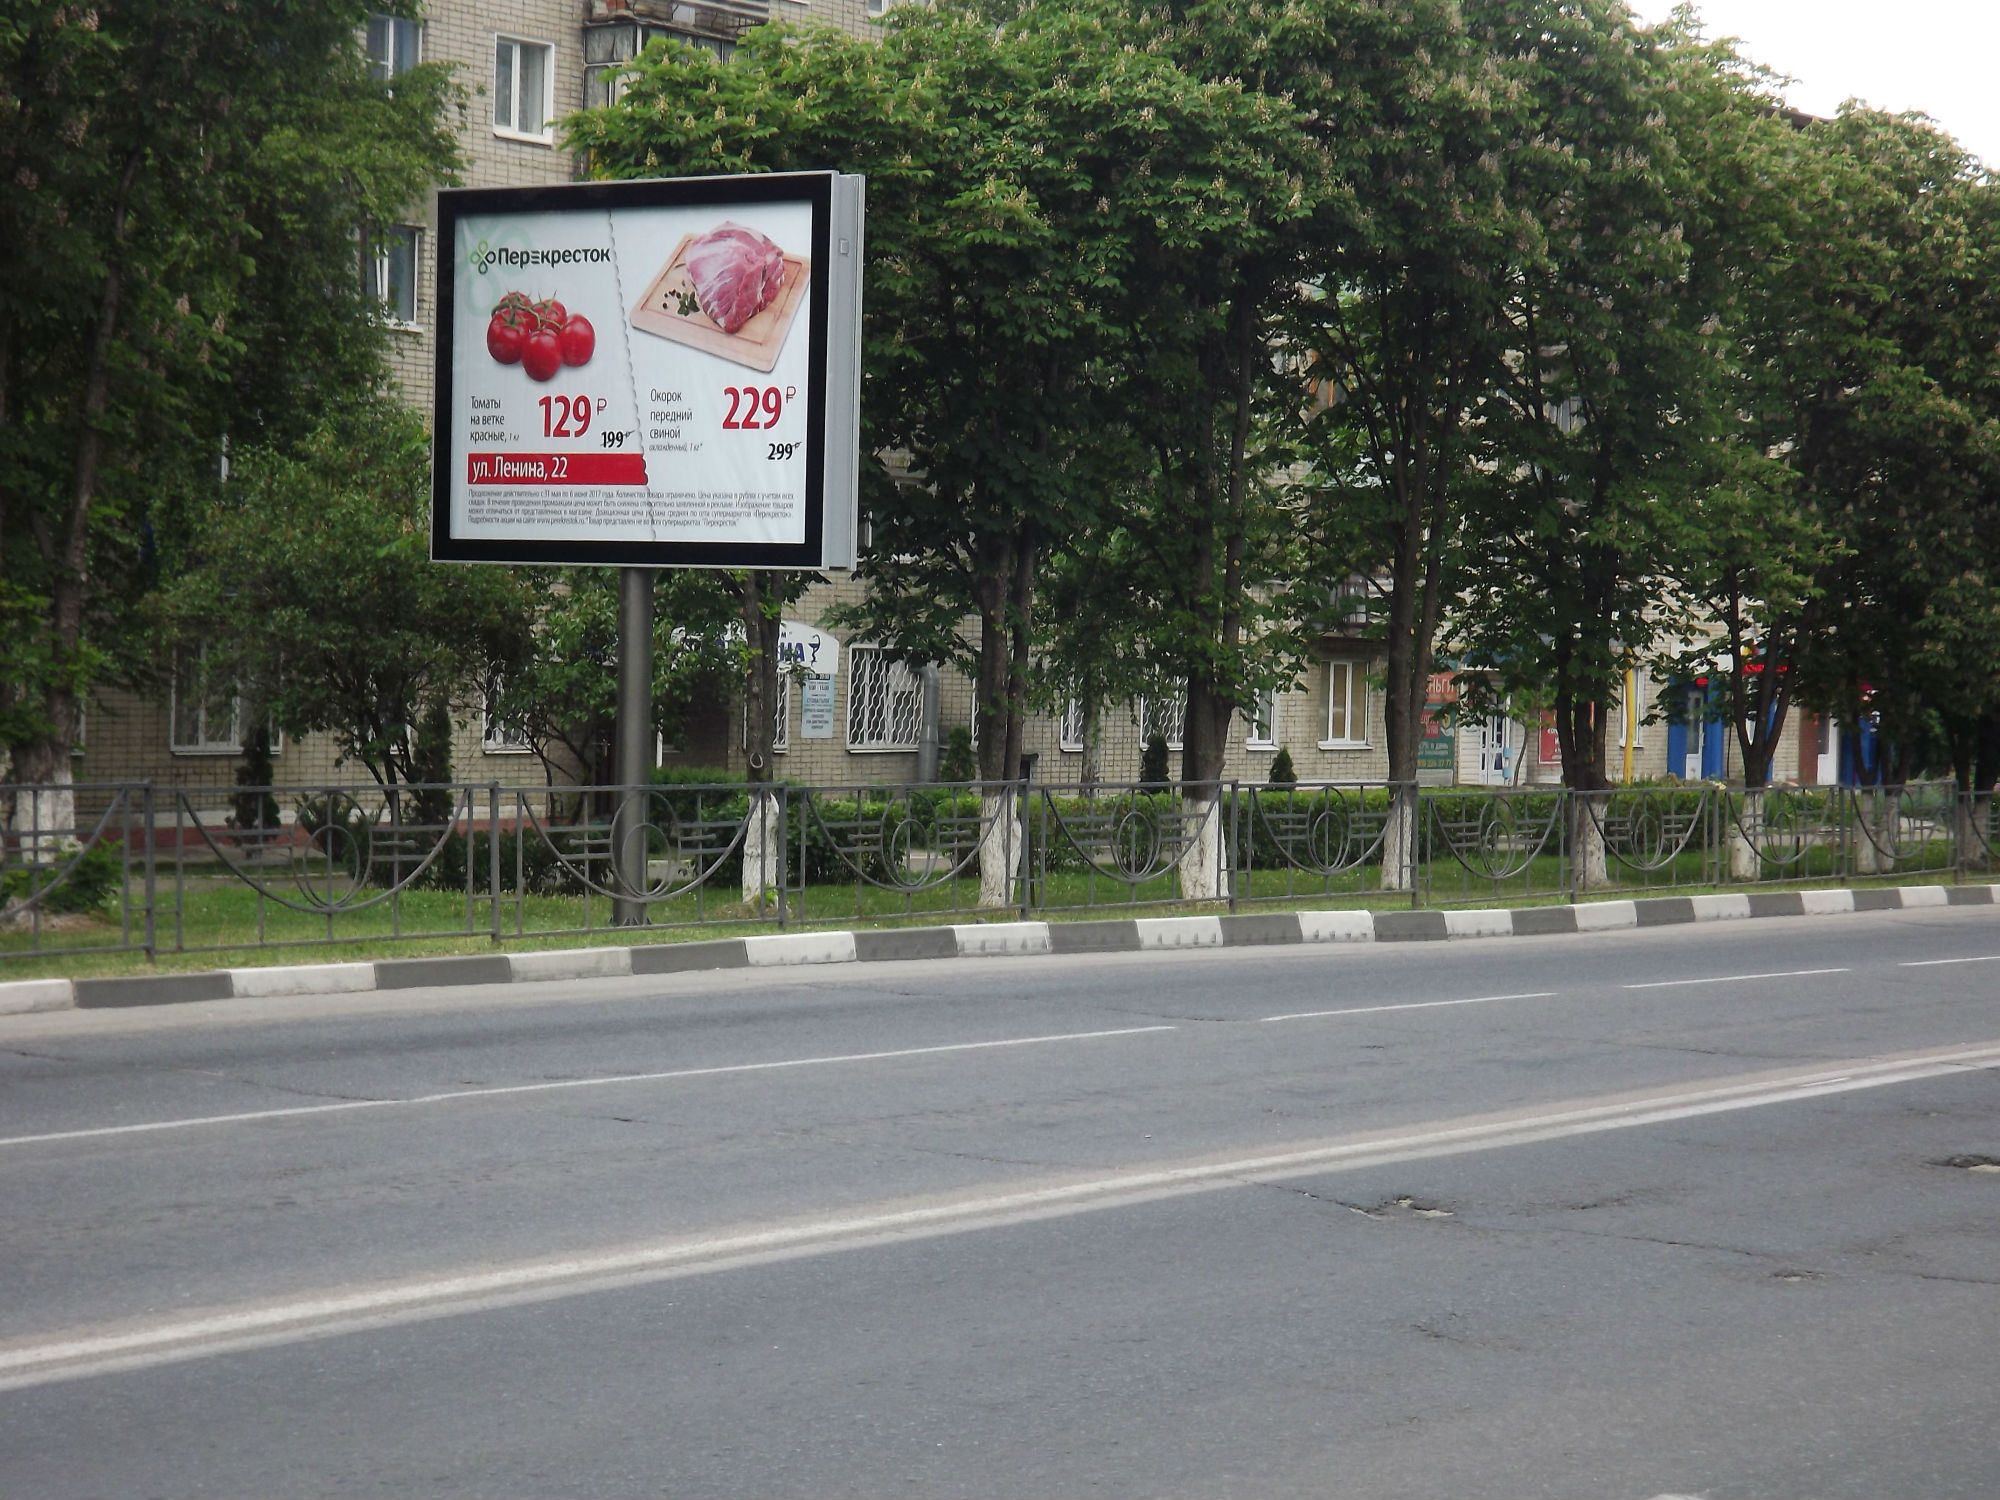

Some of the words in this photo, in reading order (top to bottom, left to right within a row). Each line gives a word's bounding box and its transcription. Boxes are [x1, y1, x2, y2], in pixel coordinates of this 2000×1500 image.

[498, 248, 610, 268] Перекресток
[471, 396, 501, 409] Томаты
[650, 389, 682, 404] Окорок
[470, 415, 481, 425] на
[482, 415, 505, 425] ветке
[650, 408, 693, 422] передний
[470, 431, 507, 445] красные,
[650, 426, 680, 439] свиной
[472, 460, 492, 481] ул.
[494, 457, 548, 480] Ленина,
[551, 458, 568, 478] 22
